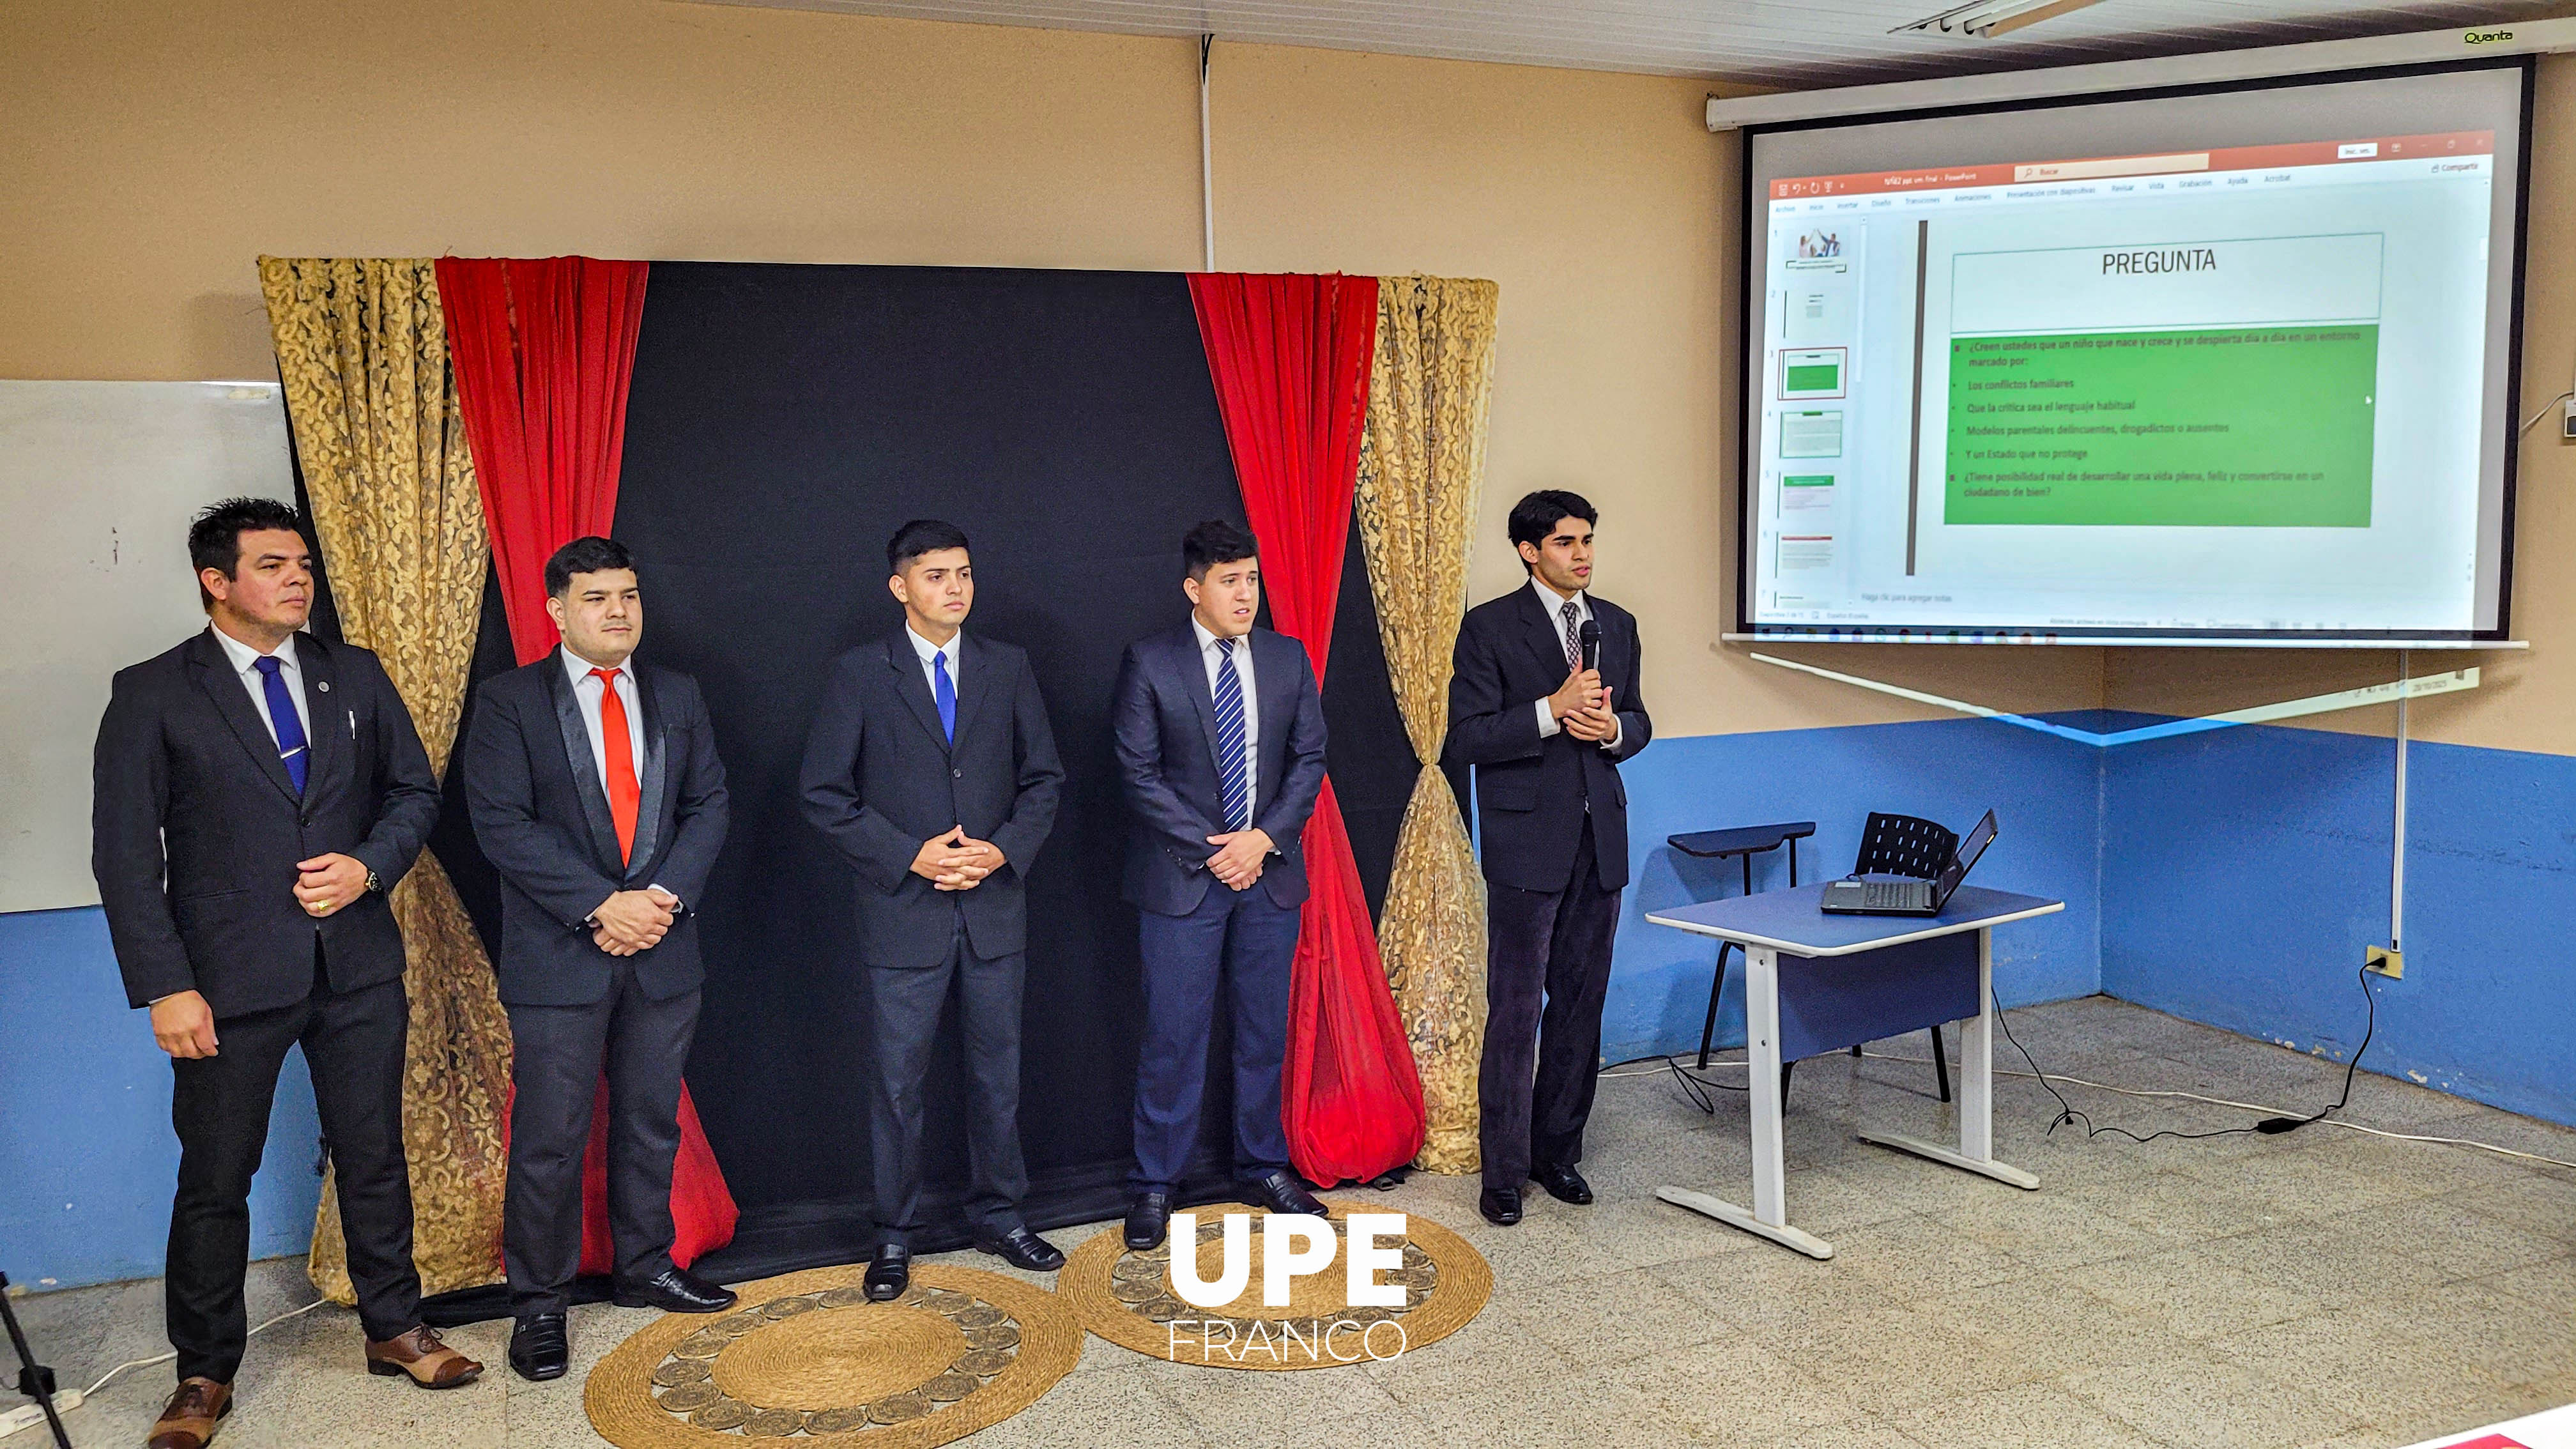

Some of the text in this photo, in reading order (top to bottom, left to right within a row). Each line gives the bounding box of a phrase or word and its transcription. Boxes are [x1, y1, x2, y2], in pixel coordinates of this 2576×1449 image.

[2464, 30, 2513, 44] Quanta
[2441, 161, 2479, 173] Compartir
[2103, 249, 2216, 275] PREGUNTA
[1969, 341, 2000, 353] ¿Creen
[2003, 341, 2037, 351] ustedes
[2039, 341, 2056, 351] que
[2059, 341, 2070, 349] un
[2073, 338, 2093, 348] niño
[2096, 339, 2113, 349] que
[2116, 339, 2137, 347] nace
[2140, 339, 2145, 349] y
[2148, 337, 2172, 346] crece
[2175, 337, 2181, 348] y
[2184, 336, 2193, 344] se
[2196, 334, 2242, 346] despierta
[2288, 333, 2301, 342] en
[2304, 332, 2317, 341] un
[2320, 331, 2361, 341] entorno
[1968, 356, 2028, 369] marcado por:
[1968, 378, 2075, 390] Los conflictos familiares
[1967, 402, 1985, 413] Que
[1988, 402, 1996, 412] la
[2027, 403, 2042, 411] sea
[2044, 401, 2053, 411] el
[2055, 401, 2094, 413] lenguaje
[2097, 399, 2135, 410] habitual
[1966, 425, 2005, 436] Modelos
[2007, 425, 2055, 436] parentales
[2057, 425, 2117, 435] delincuentes,
[2120, 424, 2175, 436] drogadictos
[2186, 424, 2229, 433] ausentes
[1966, 449, 1972, 459] Y
[1987, 449, 2017, 459] Estado
[2019, 450, 2036, 461] que
[2052, 450, 2088, 460] protege
[1965, 472, 1993, 483] ¿Tiene
[1996, 471, 2044, 482] posibilidad
[2046, 471, 2064, 481] real
[2067, 471, 2078, 481] de
[2080, 471, 2130, 481] desarrollar
[2153, 471, 2173, 481] vida
[2207, 471, 2227, 481] feliz
[2238, 471, 2292, 480] convertirse
[1964, 487, 2051, 497] ciudadano de bien?
